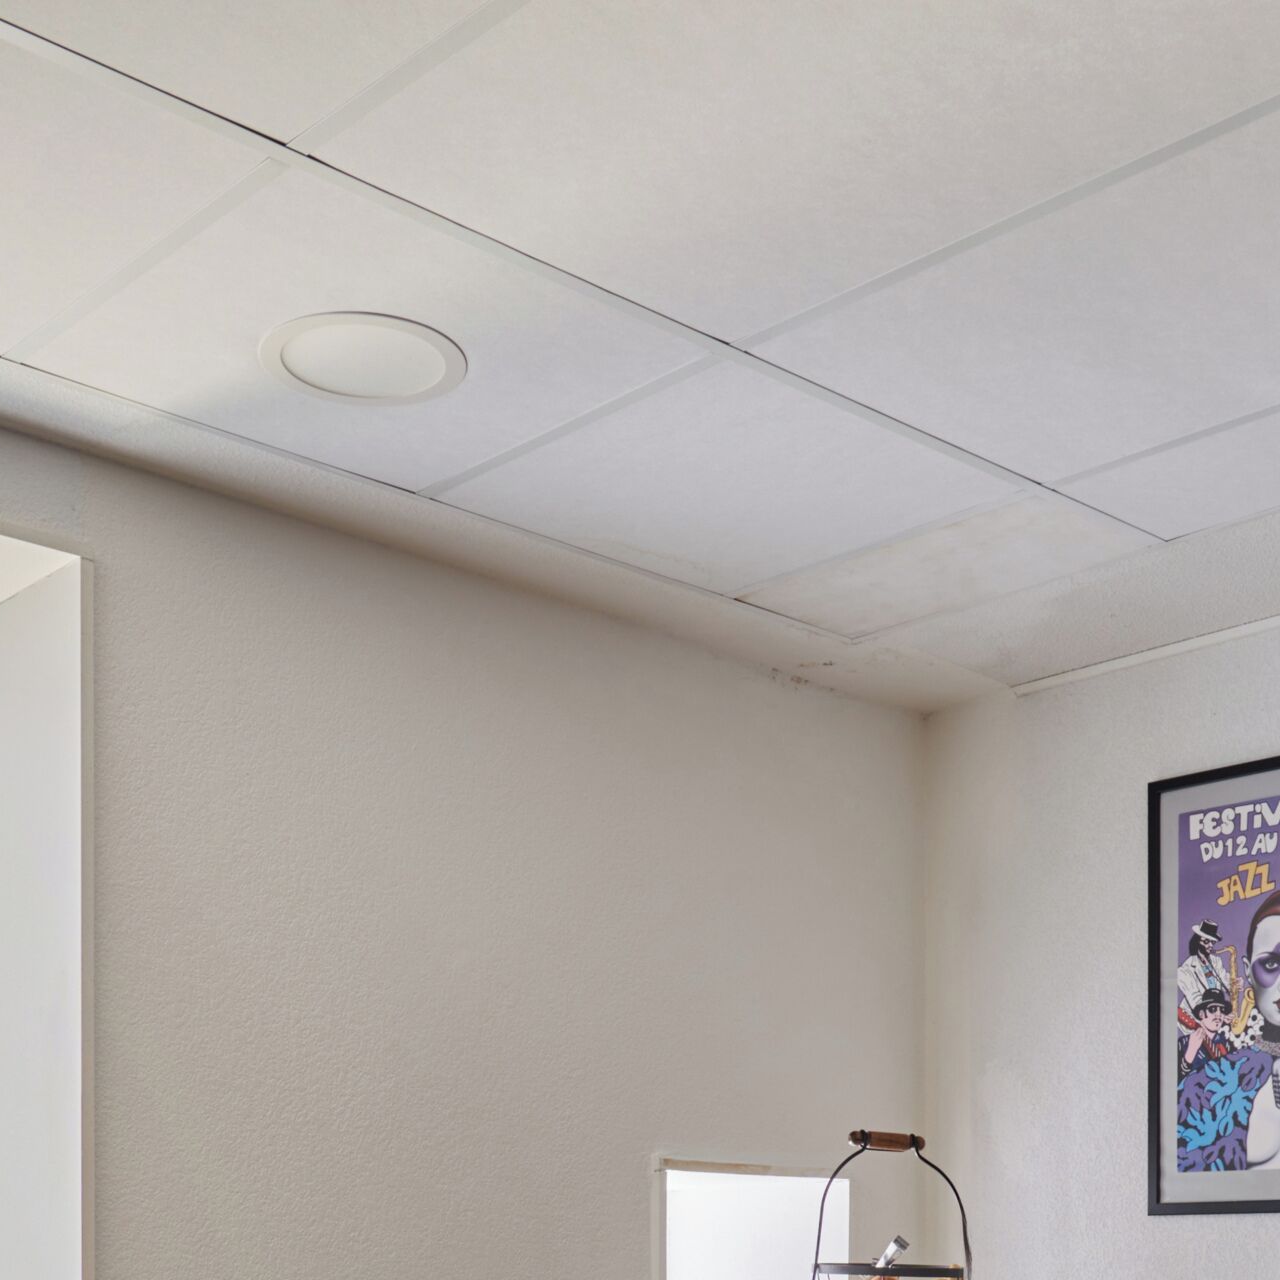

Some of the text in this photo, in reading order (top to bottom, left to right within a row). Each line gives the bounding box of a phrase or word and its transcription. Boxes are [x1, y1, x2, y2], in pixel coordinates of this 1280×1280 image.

[1199, 839, 1223, 863] DU
[1224, 835, 1248, 856] 12
[1251, 832, 1277, 855] AU
[1216, 860, 1276, 906] JAZZ
